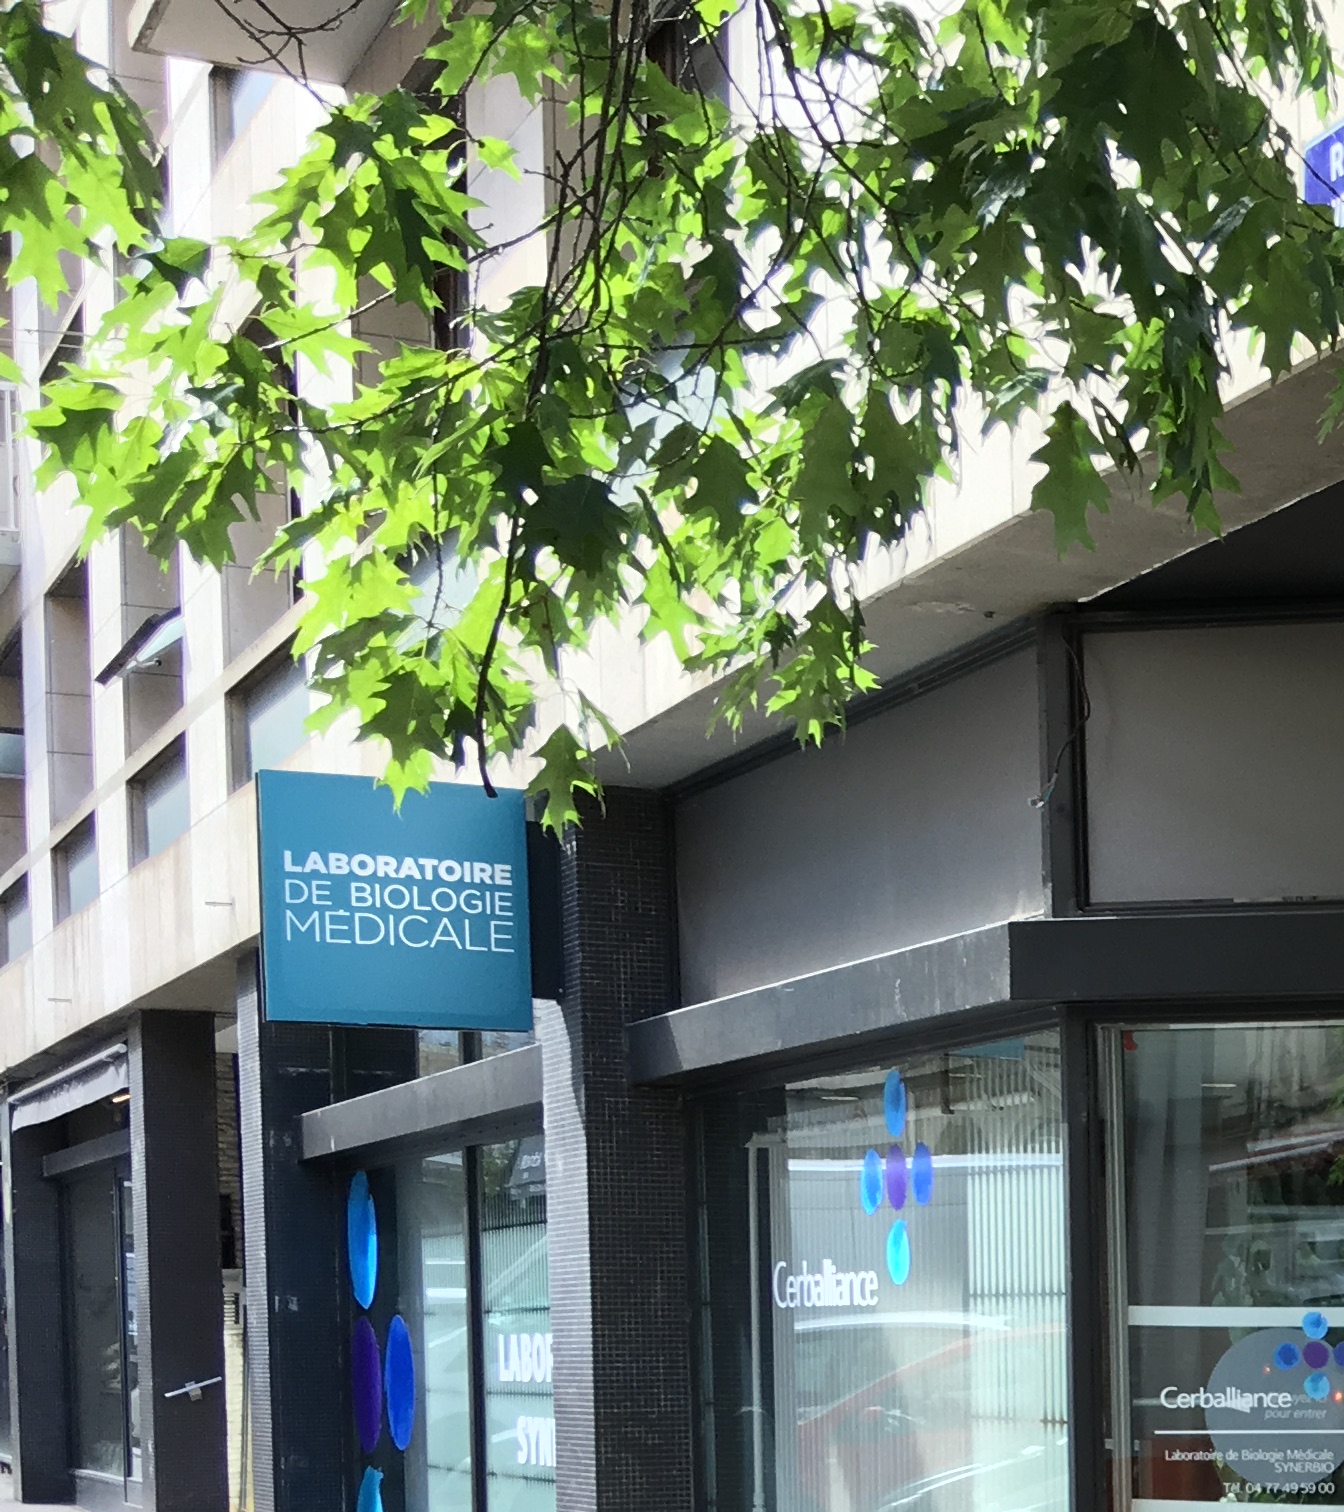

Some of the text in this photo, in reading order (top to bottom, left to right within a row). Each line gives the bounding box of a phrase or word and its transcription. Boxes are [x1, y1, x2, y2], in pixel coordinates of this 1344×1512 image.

[283, 850, 513, 886] LABORATOIRE
[285, 879, 514, 917] DE BIOLOGIE
[285, 908, 515, 953] MÉDICALE
[773, 1259, 879, 1309] Cerballiance
[1160, 1386, 1291, 1409] Cerballiance
[1265, 1409, 1327, 1420] pour entrer
[1165, 1449, 1334, 1463] Laboratoire de Biologie Médicale
[1274, 1462, 1334, 1474] SYNERBIO
[1245, 1482, 1261, 1494] 04
[1265, 1482, 1282, 1494] 77
[1284, 1482, 1298, 1494] 49
[1300, 1482, 1316, 1494] 59
[1318, 1482, 1335, 1494] 00
